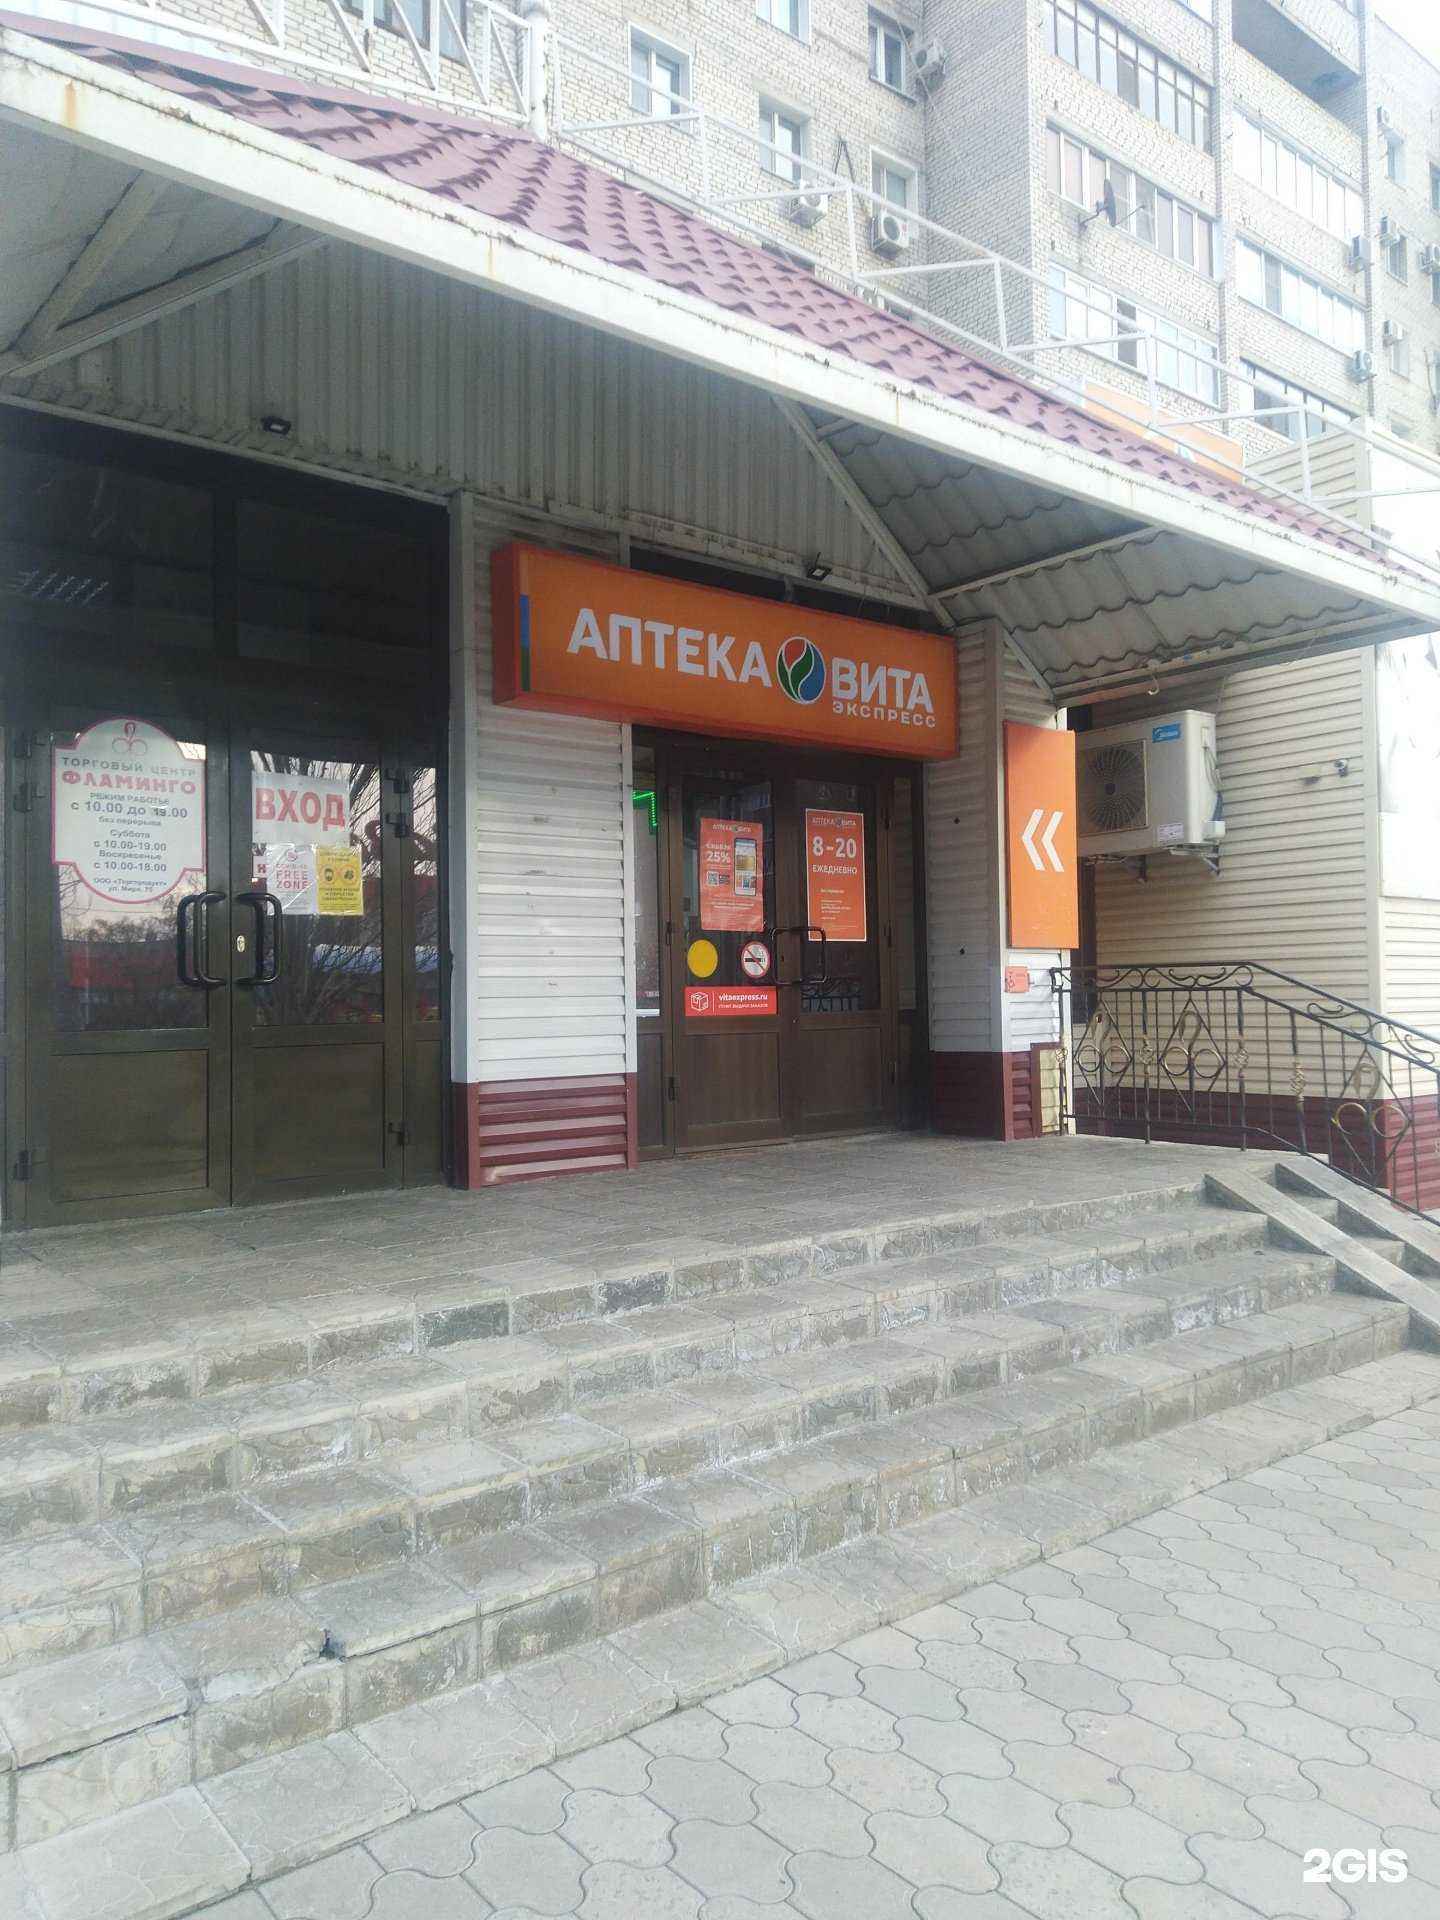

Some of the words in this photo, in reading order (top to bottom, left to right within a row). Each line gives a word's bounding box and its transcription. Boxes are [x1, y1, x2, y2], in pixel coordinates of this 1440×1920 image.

[566, 607, 773, 687] АПТЕКА
[831, 656, 935, 713] ВИТА
[832, 700, 938, 728] ЭКСПРЕСС
[62, 757, 144, 772] ТОРГОВЫЙ
[61, 770, 197, 794] ФЛАМИНГО
[90, 792, 124, 801] РЕЖИМ
[85, 801, 123, 813] 10.00
[255, 787, 346, 832] ВХОД
[110, 829, 151, 838] Суббота
[104, 840, 168, 851] 10.00-19.00
[705, 850, 731, 863] 25%
[276, 870, 308, 880] FREE
[812, 864, 858, 875] ЕЖЕДНЕВНО
[276, 880, 308, 890] ZONE
[719, 993, 768, 1002] vitaexpress.ru
